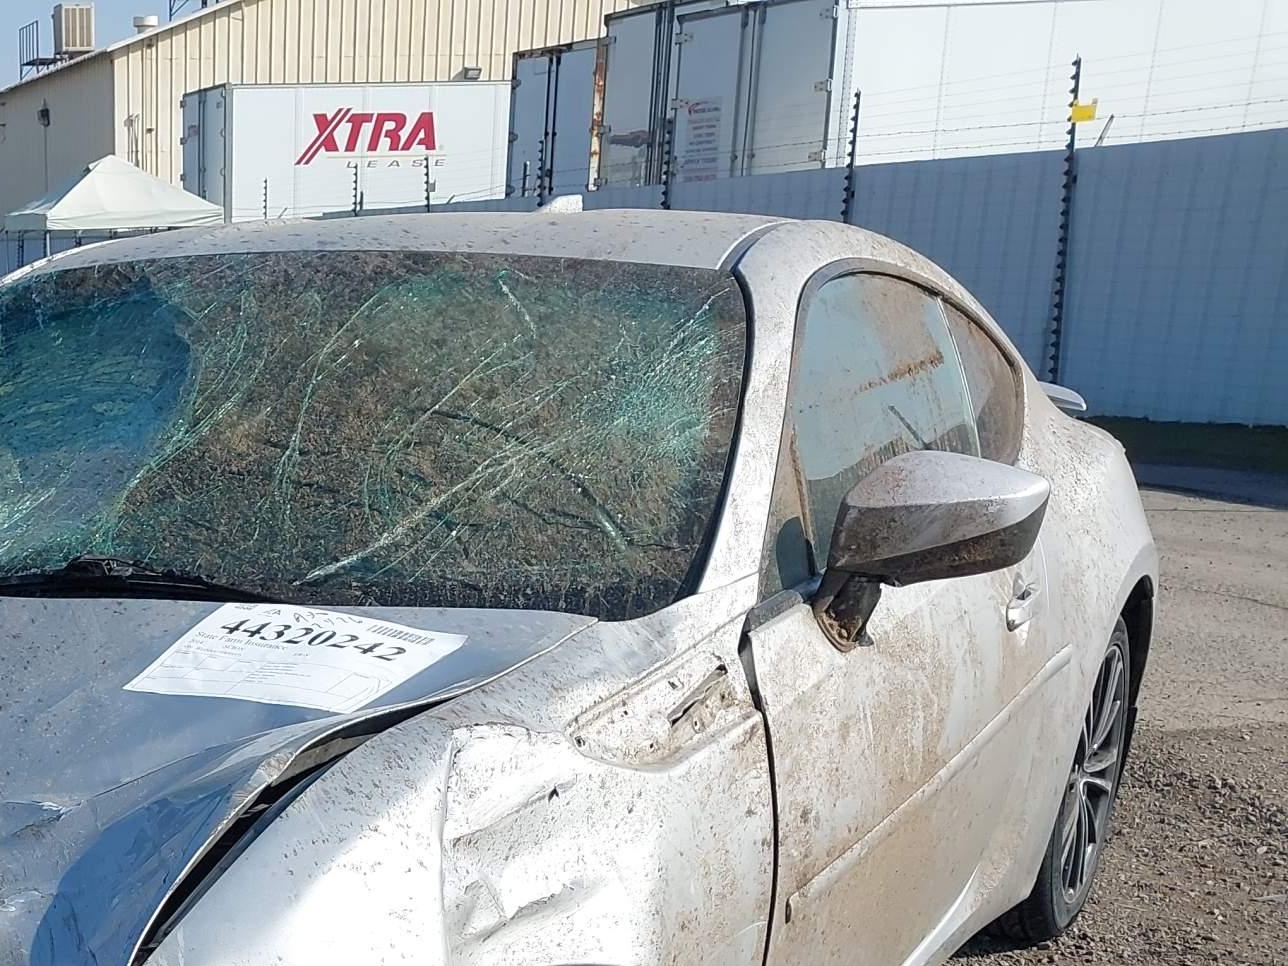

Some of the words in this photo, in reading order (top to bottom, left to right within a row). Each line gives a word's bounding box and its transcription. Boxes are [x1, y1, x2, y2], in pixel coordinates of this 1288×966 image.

[294, 107, 437, 166] XTRA
[346, 159, 446, 168] LEASE
[195, 631, 218, 640] State
[218, 634, 243, 644] Farm
[244, 638, 288, 651] Insurance
[220, 618, 406, 661] 44320242
